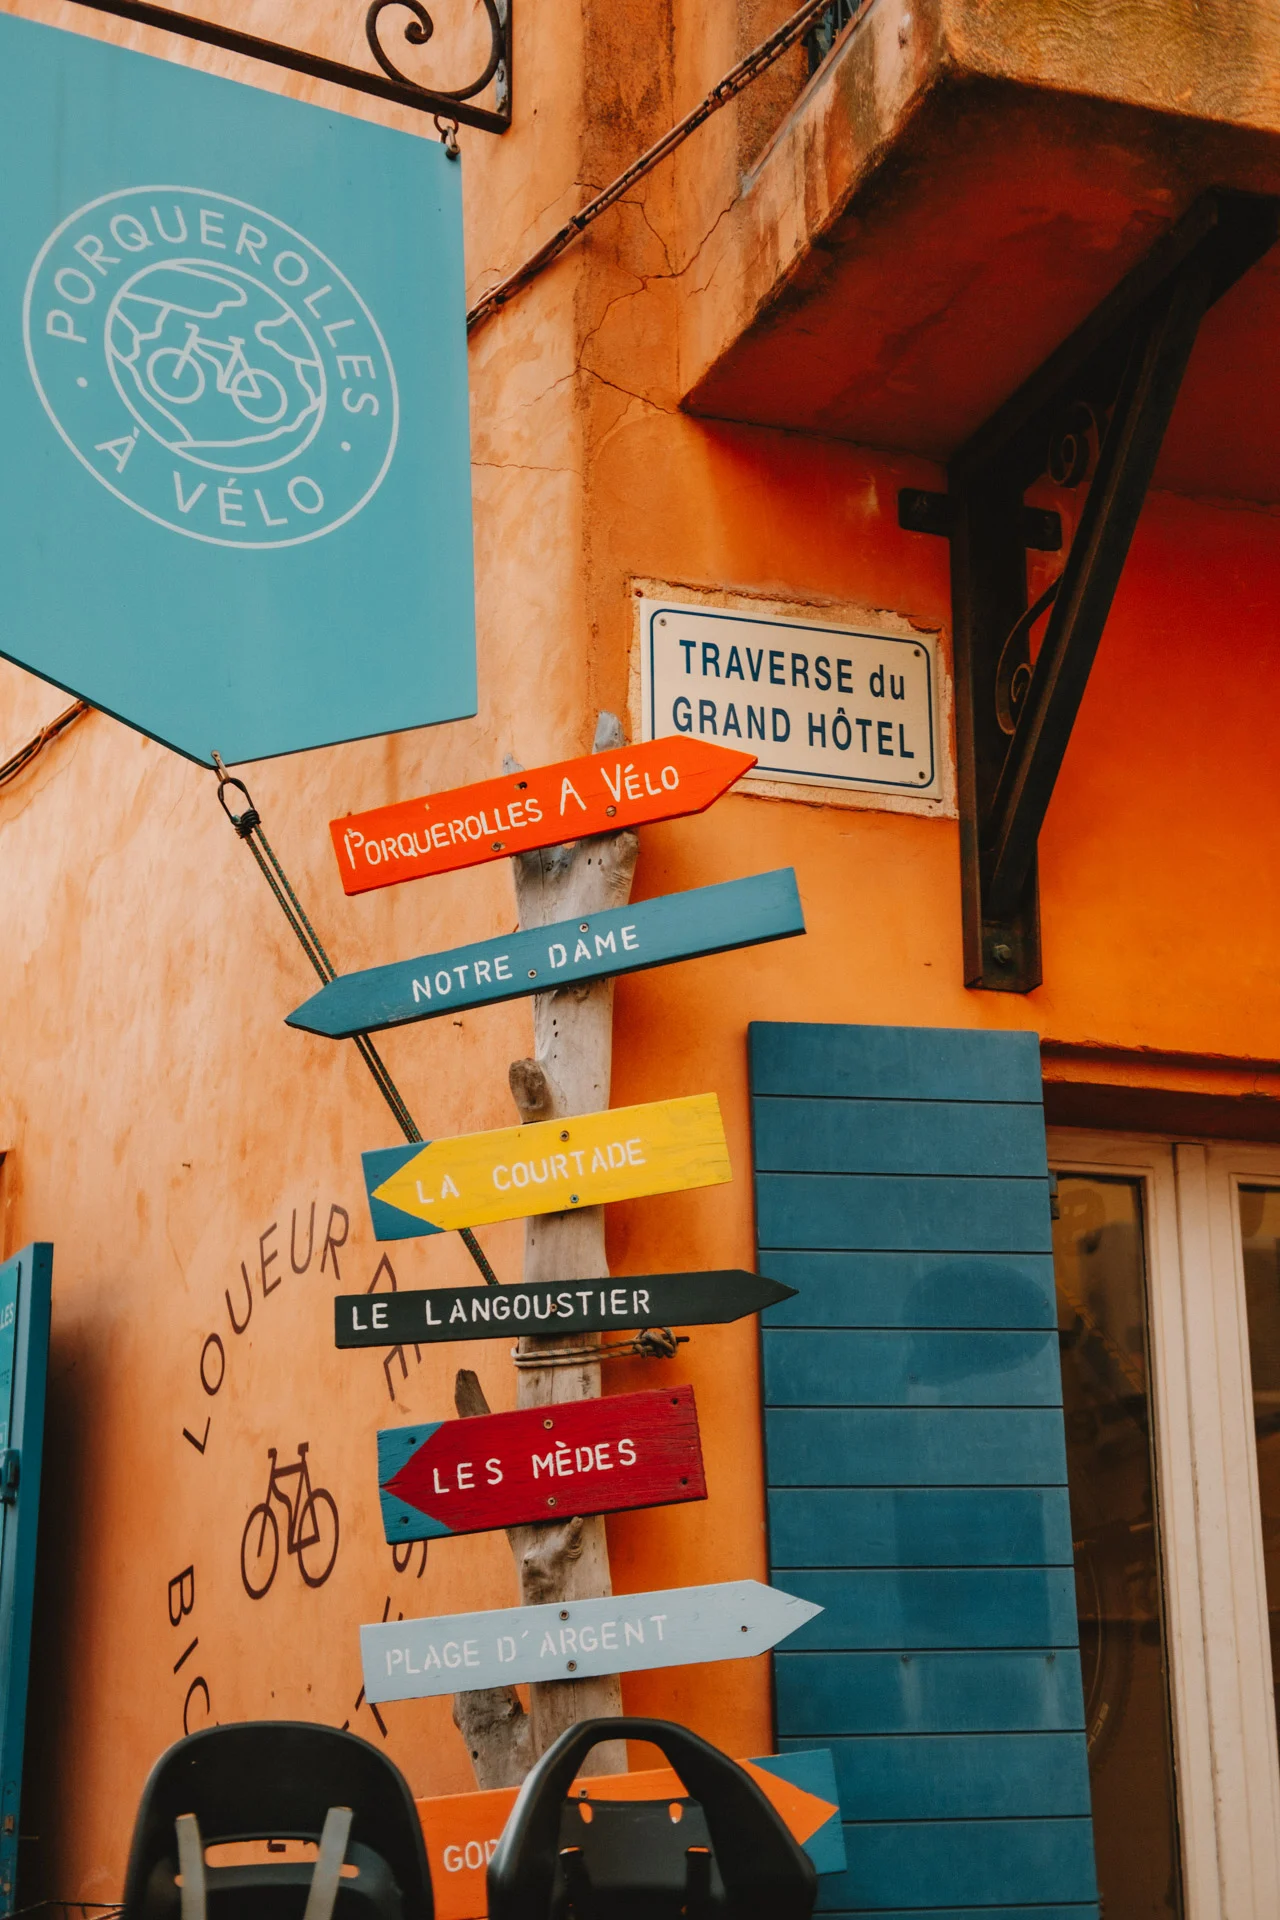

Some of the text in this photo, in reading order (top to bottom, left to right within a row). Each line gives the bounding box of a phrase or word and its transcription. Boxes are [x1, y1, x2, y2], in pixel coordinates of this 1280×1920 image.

[46, 205, 380, 418] PORQUEROLLES
[173, 470, 324, 528] VÉLO
[678, 639, 906, 701] TRAVERSE du
[671, 696, 915, 759] GRAND HÔTEL
[343, 762, 681, 870] PORQUEROLLES A VÉLO
[412, 924, 641, 1004] NOTRE DAME
[415, 1137, 647, 1205] LA COURTADE
[182, 1201, 350, 1457] LOUEUR
[351, 1288, 652, 1332] LE LANGOUSTIER
[432, 1437, 638, 1495] LES MÈDES
[385, 1638, 482, 1677] PLAGE
